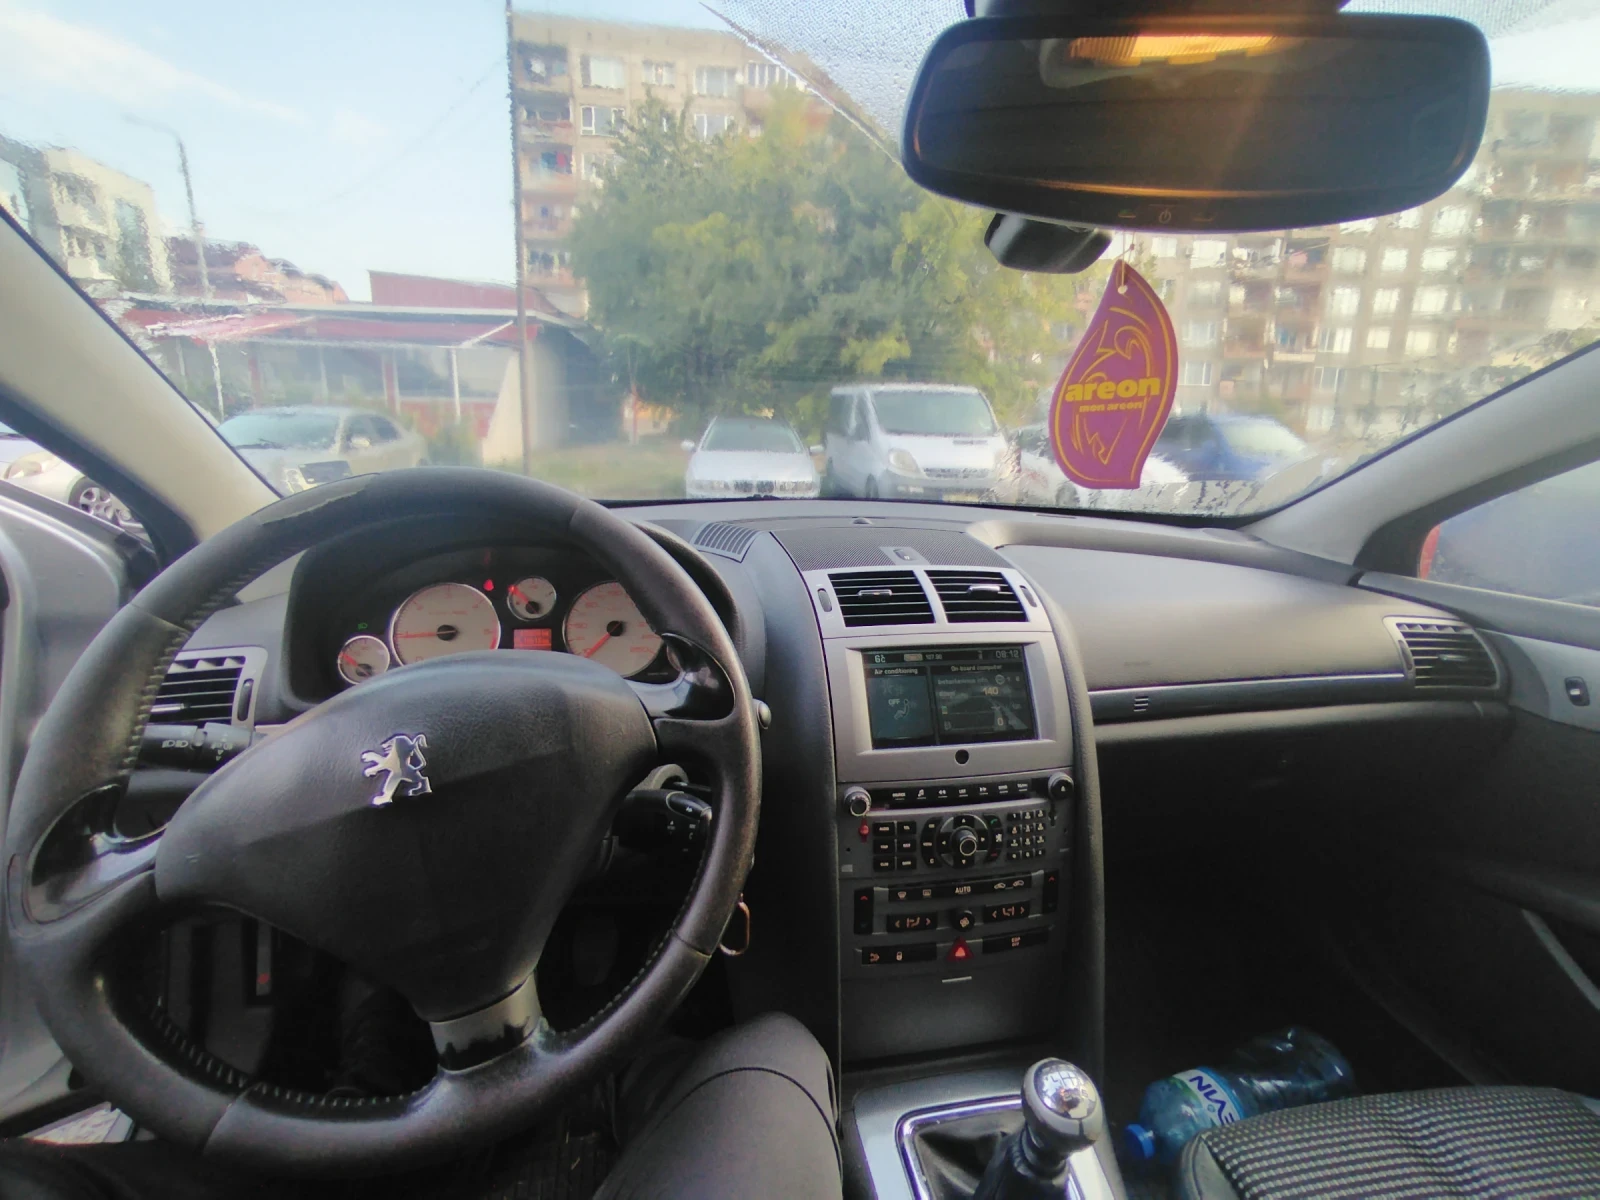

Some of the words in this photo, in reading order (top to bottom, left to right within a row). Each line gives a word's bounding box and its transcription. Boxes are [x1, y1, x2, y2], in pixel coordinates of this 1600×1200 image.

[1065, 377, 1161, 402] areon
[1079, 403, 1105, 412] mon
[1107, 402, 1144, 411] areon
[884, 667, 918, 676] conditioning
[983, 686, 999, 696] 140
[955, 886, 971, 894] AUTO
